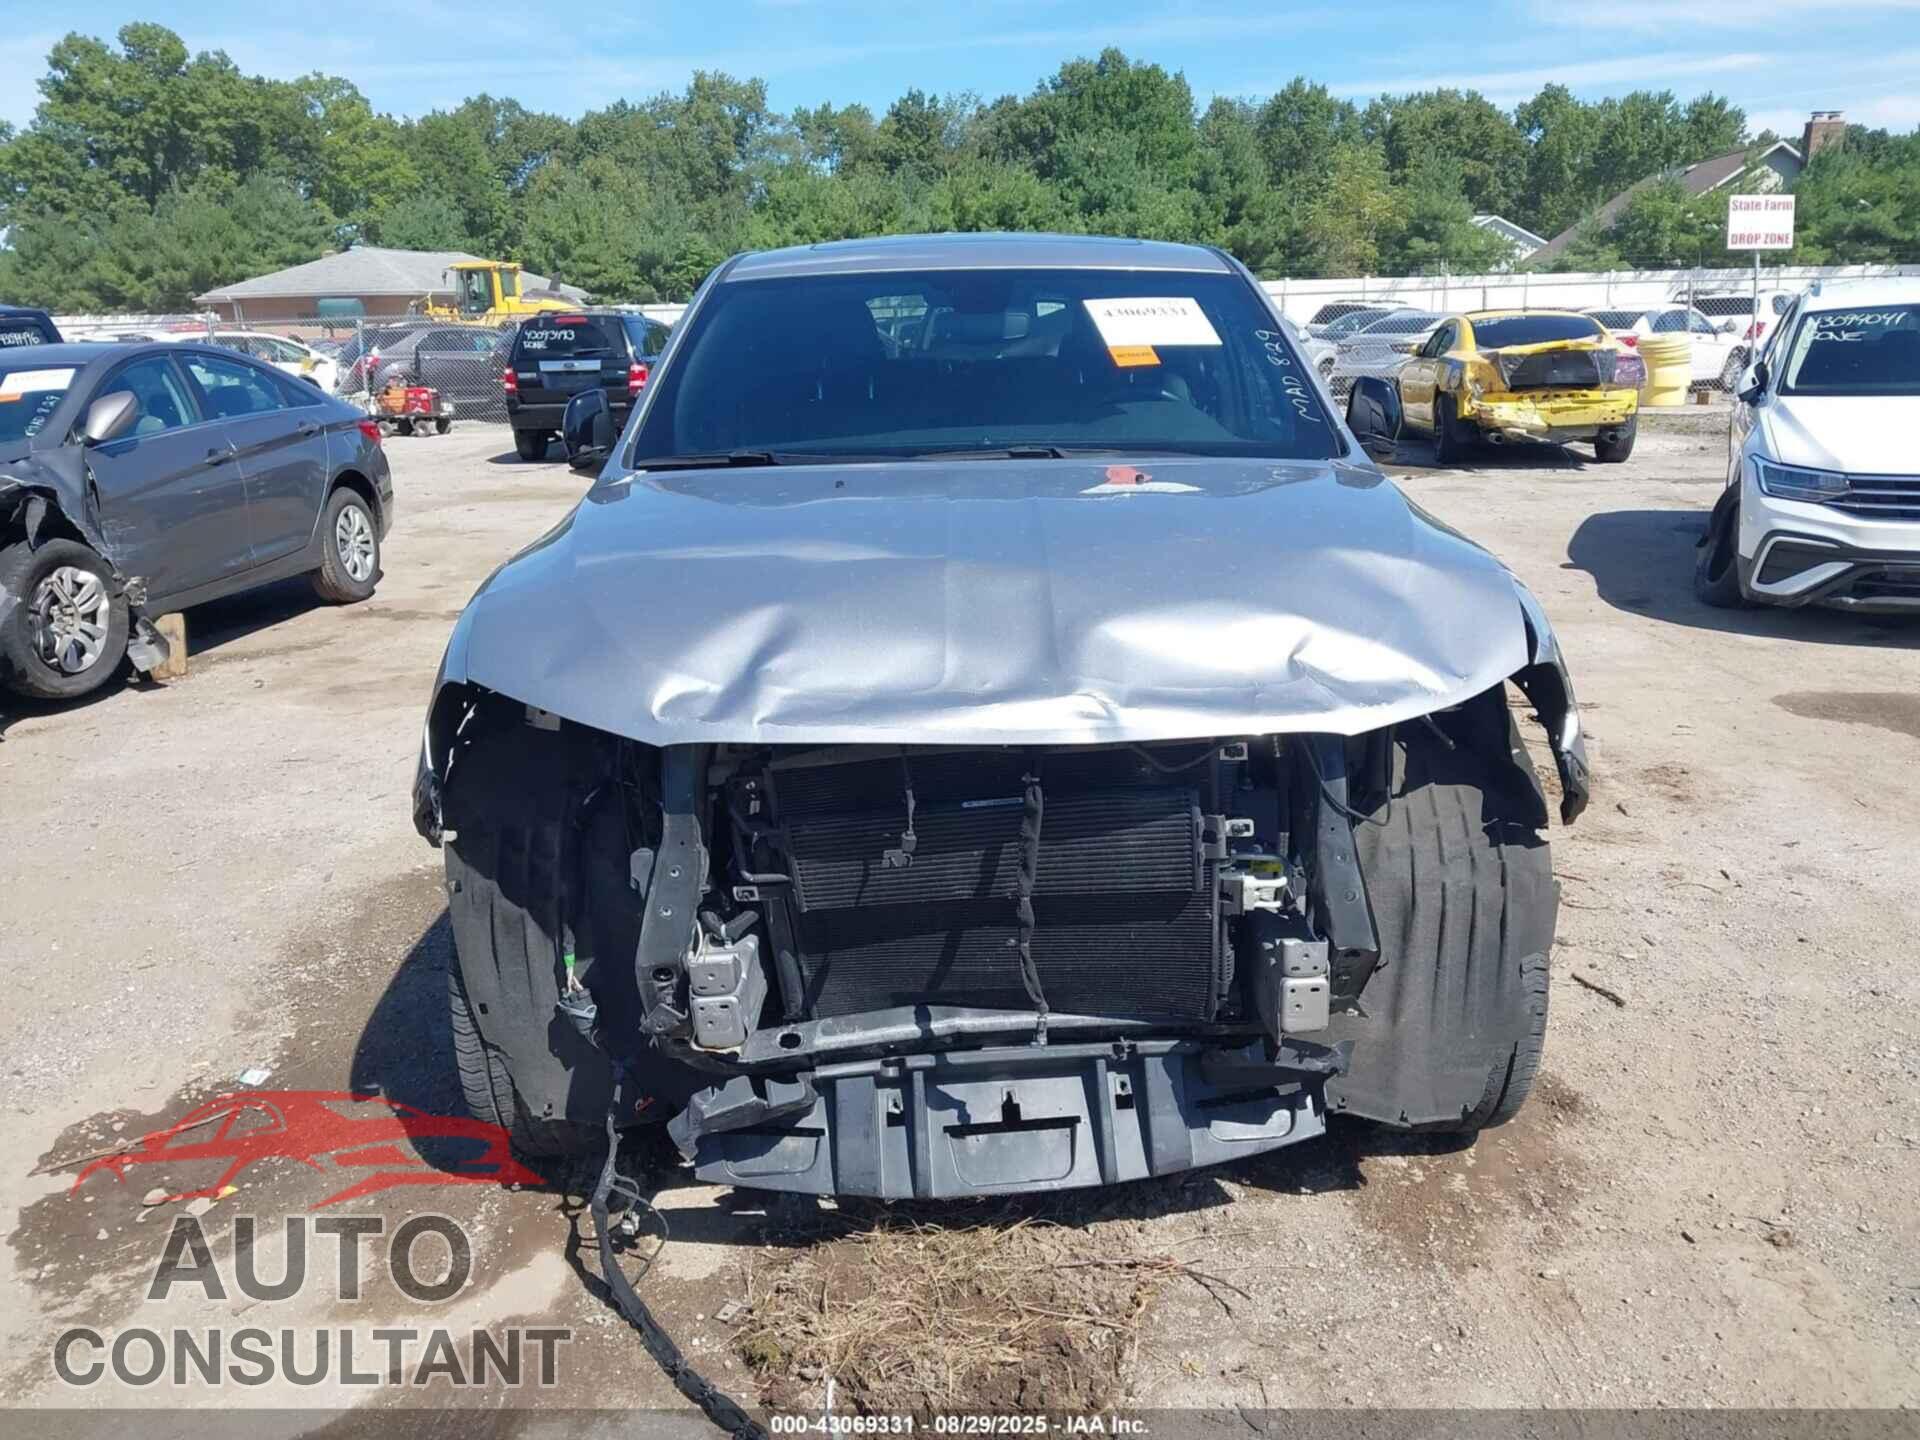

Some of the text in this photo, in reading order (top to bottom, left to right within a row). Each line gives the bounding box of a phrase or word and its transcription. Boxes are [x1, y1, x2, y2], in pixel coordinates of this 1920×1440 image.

[1731, 200, 1793, 212] State Farm
[1730, 233, 1790, 245] DROP ZONE
